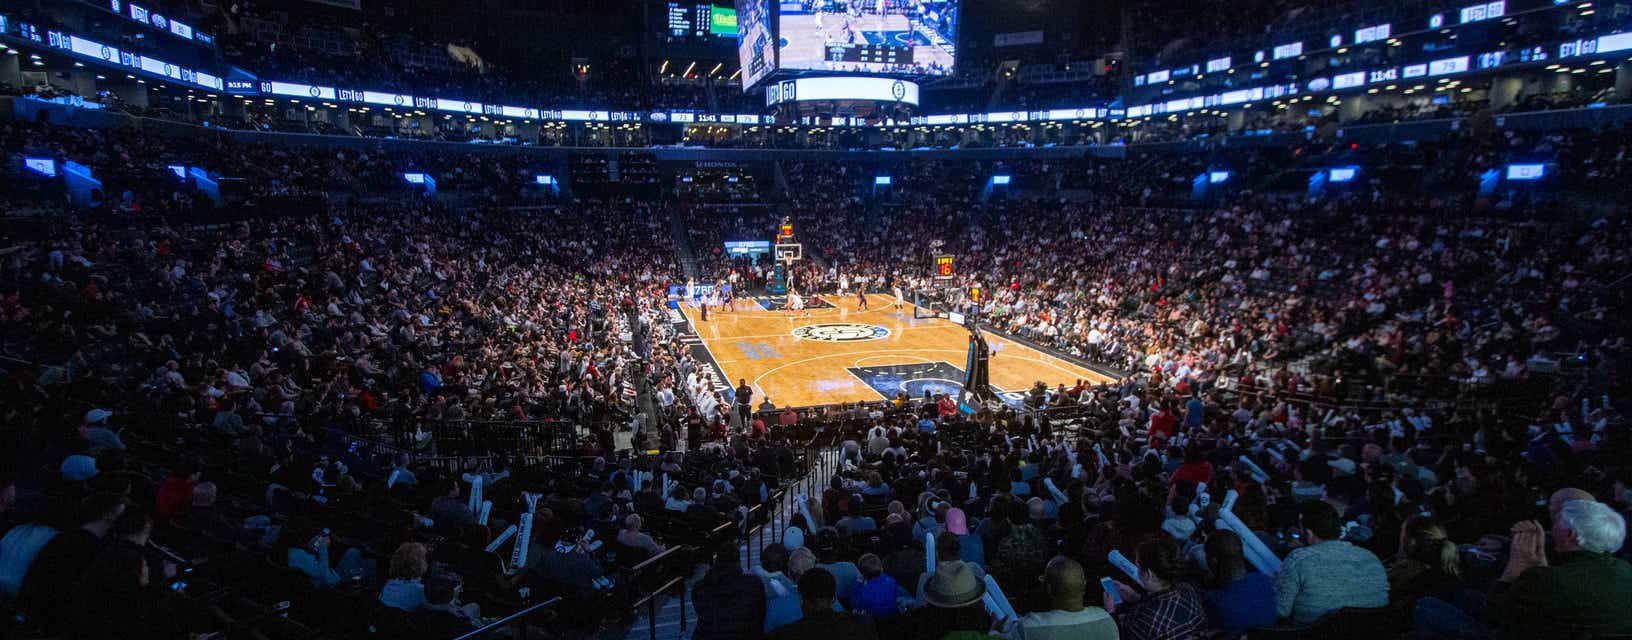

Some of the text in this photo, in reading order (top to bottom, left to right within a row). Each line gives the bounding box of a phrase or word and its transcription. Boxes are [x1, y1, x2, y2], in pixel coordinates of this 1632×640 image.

[261, 82, 271, 93] GO
[783, 82, 795, 100] GO
[355, 91, 363, 101] GO
[698, 114, 717, 122] 11:41
